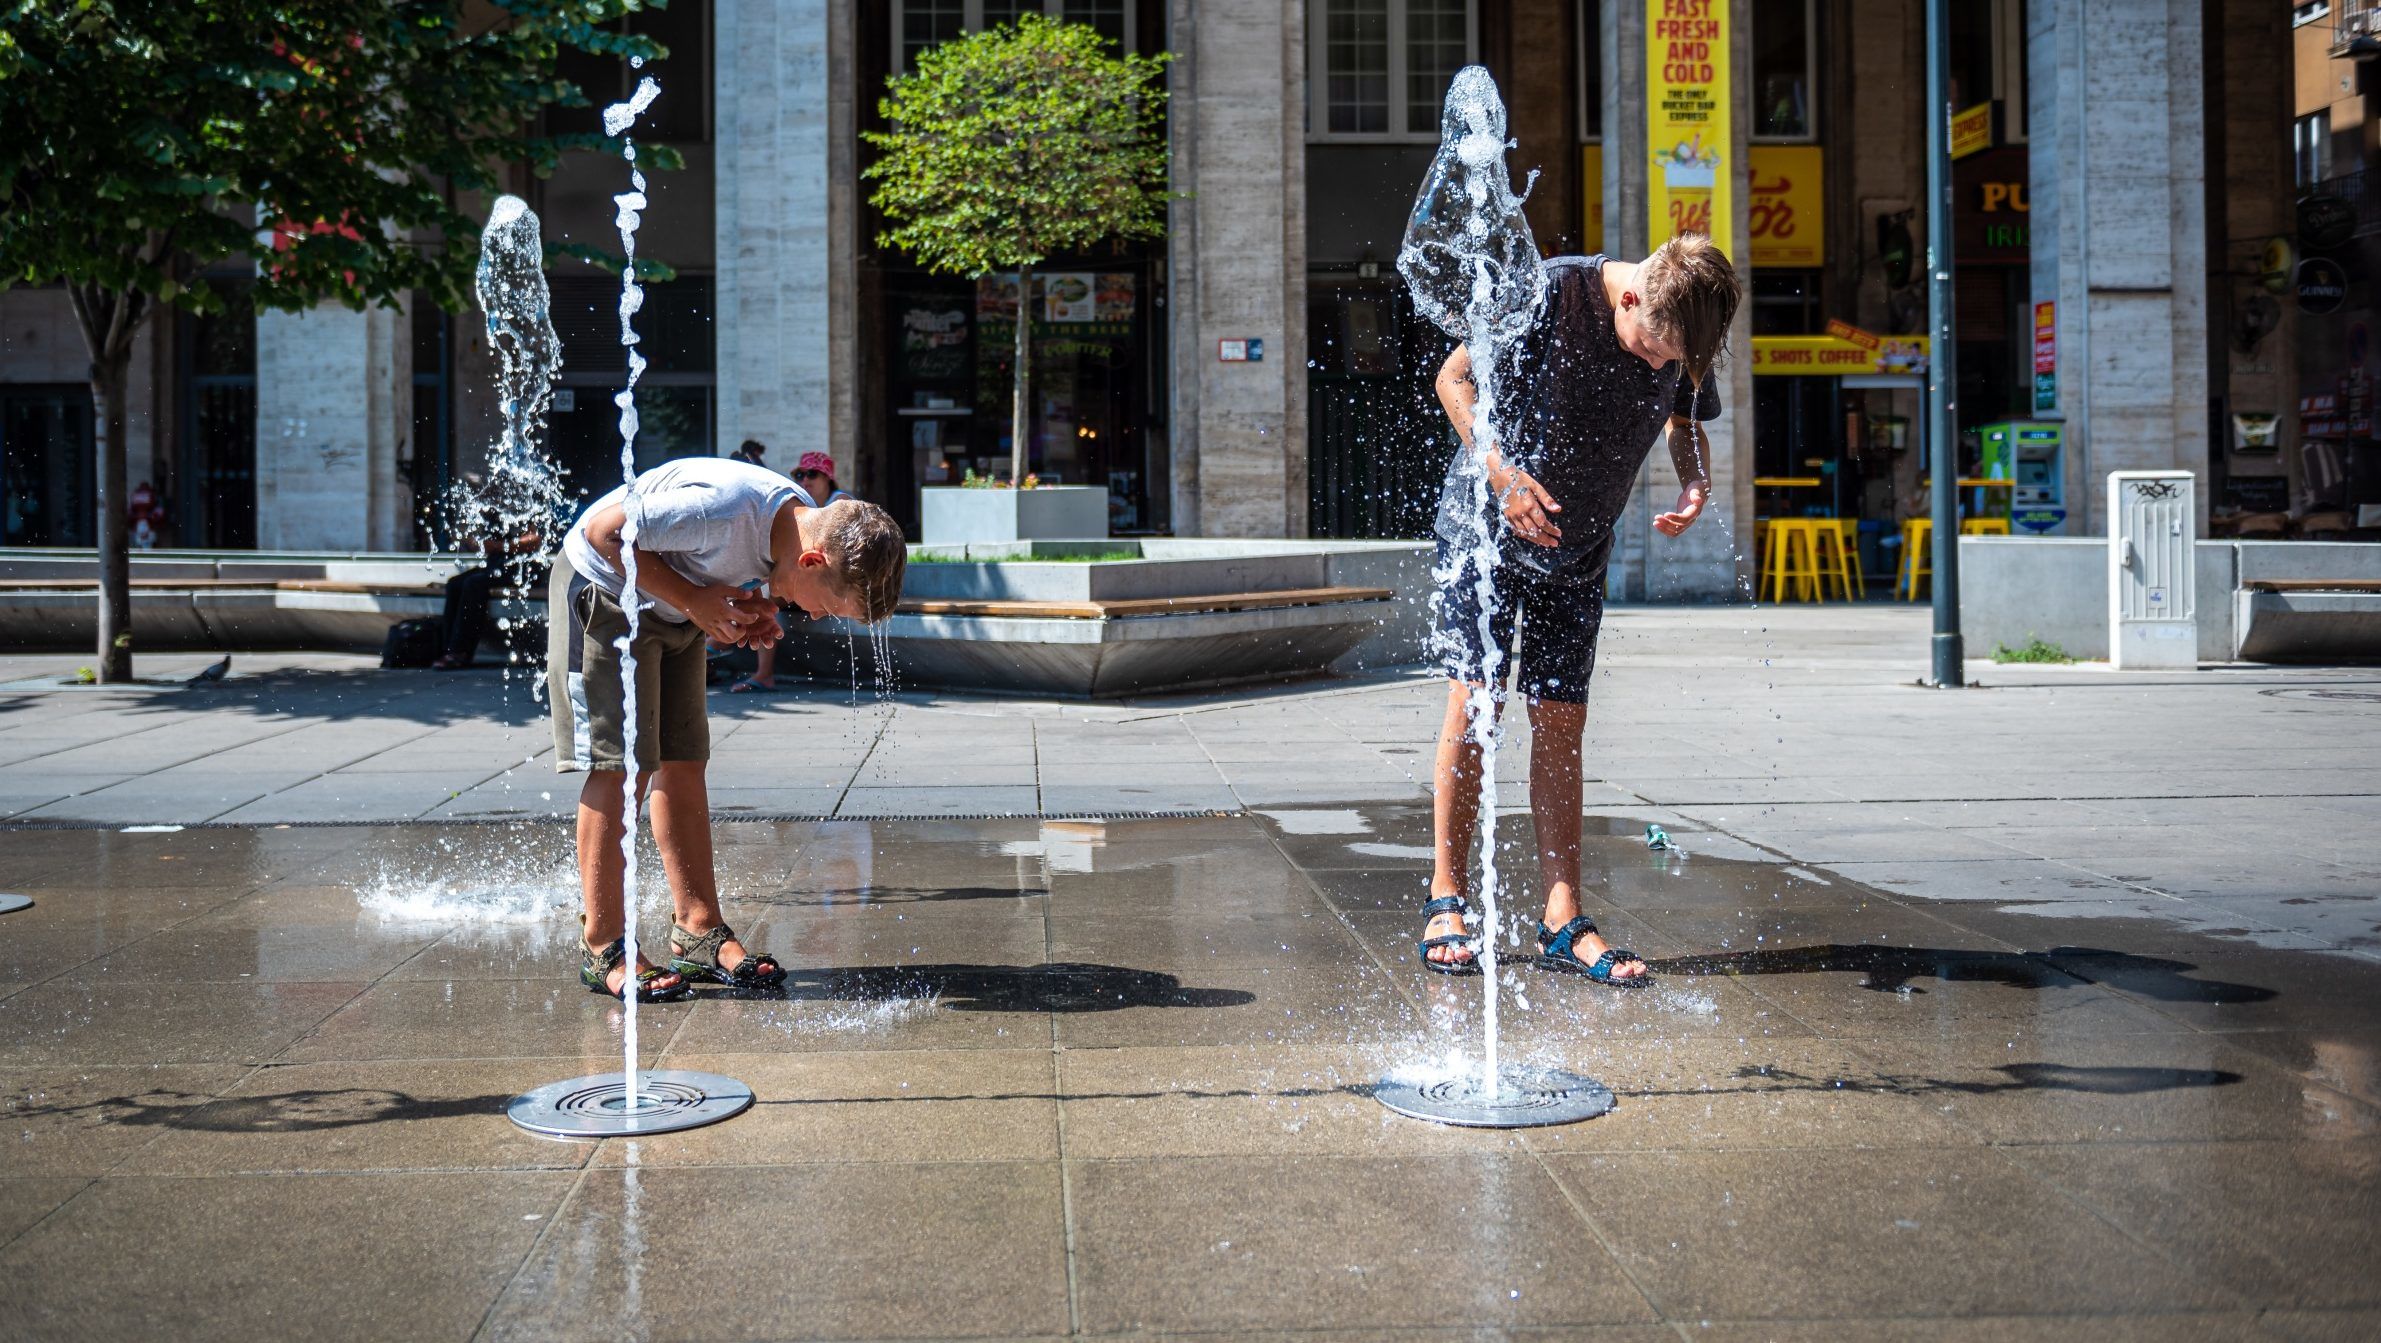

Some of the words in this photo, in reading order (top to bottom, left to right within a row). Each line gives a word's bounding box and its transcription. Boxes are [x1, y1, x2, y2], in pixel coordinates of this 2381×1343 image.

[1663, 0, 1711, 17] FAST
[1656, 20, 1719, 40] FRESH
[1667, 42, 1709, 61] AND
[1663, 64, 1714, 84] COLD
[1667, 90, 1684, 99] THE
[1981, 183, 2030, 213] PU
[1770, 350, 1812, 364] SHOTS
[1818, 350, 1867, 364] COFFEE
